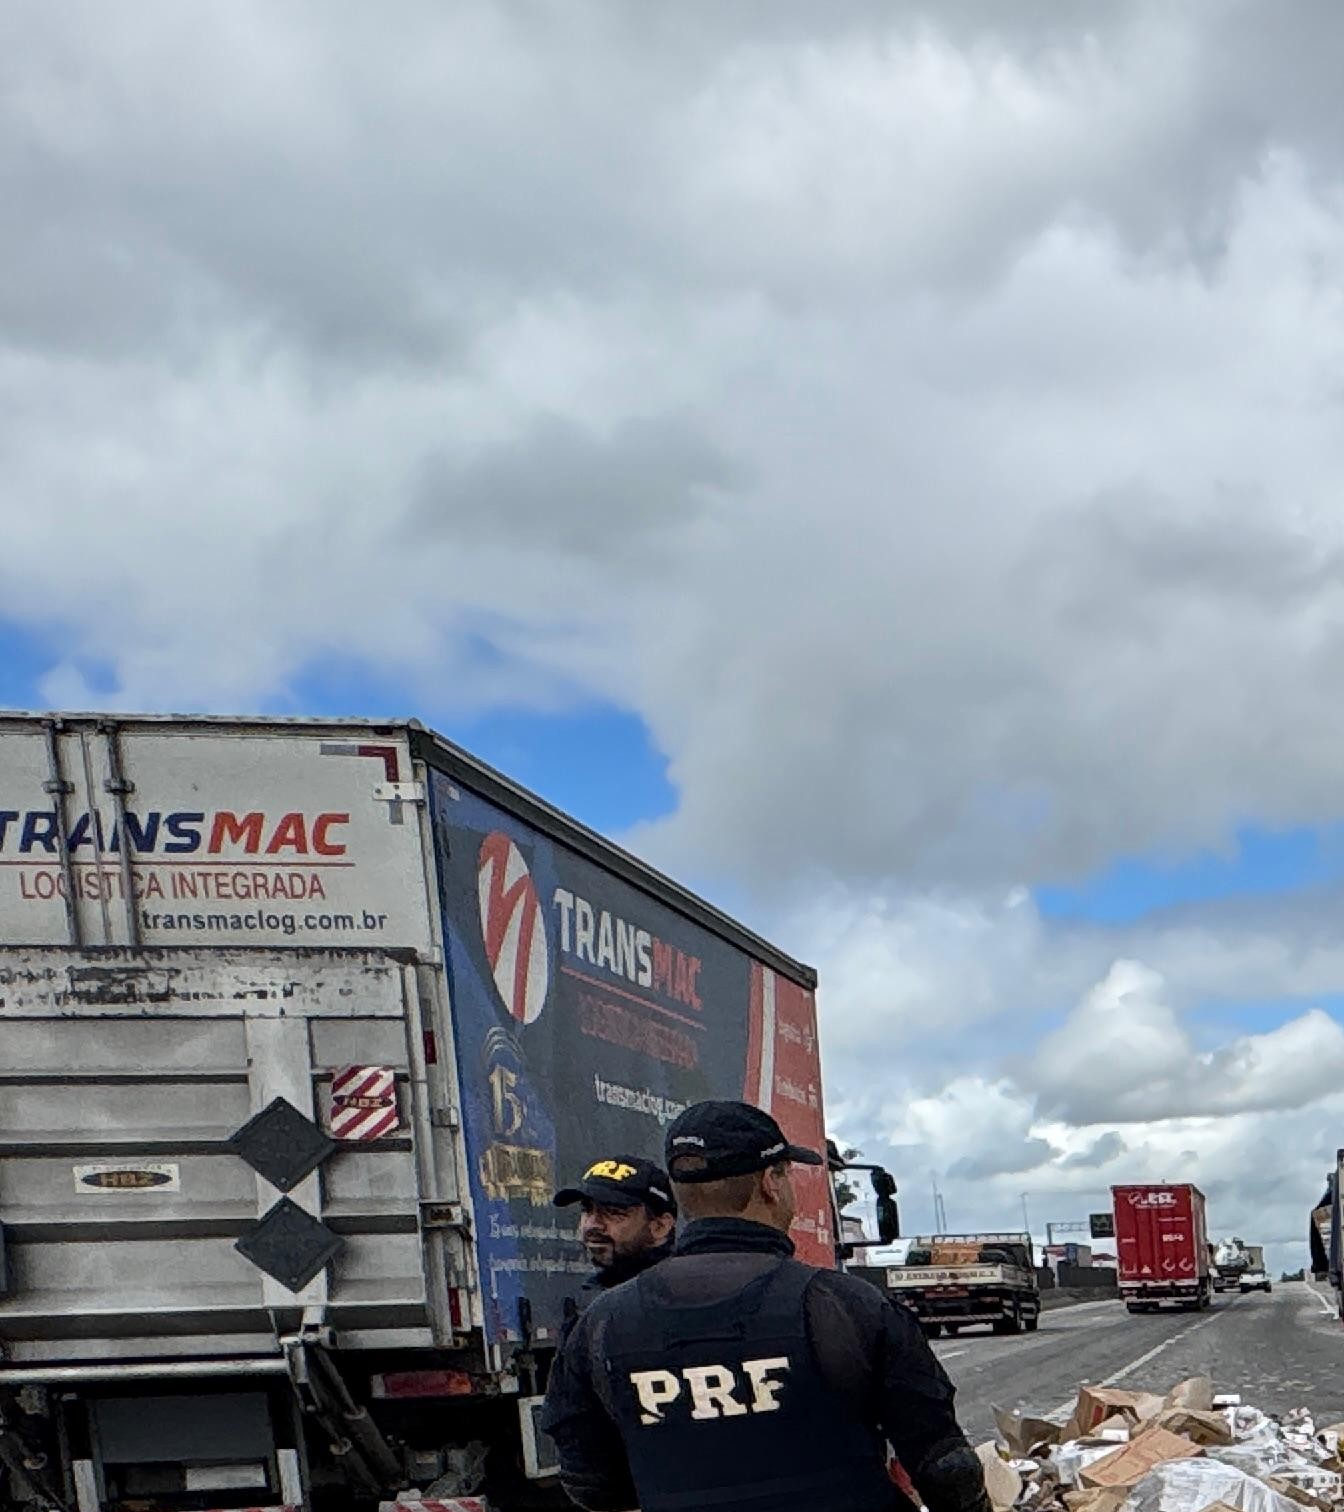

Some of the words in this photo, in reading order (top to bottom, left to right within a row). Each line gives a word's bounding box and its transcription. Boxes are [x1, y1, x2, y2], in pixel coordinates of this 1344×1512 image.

[172, 872, 326, 900] INTEGRADA
[143, 909, 388, 935] transmaclog.com.br
[553, 888, 703, 1011] TRANSMAC
[582, 1160, 638, 1181] PRF
[630, 1356, 791, 1425] PRF
